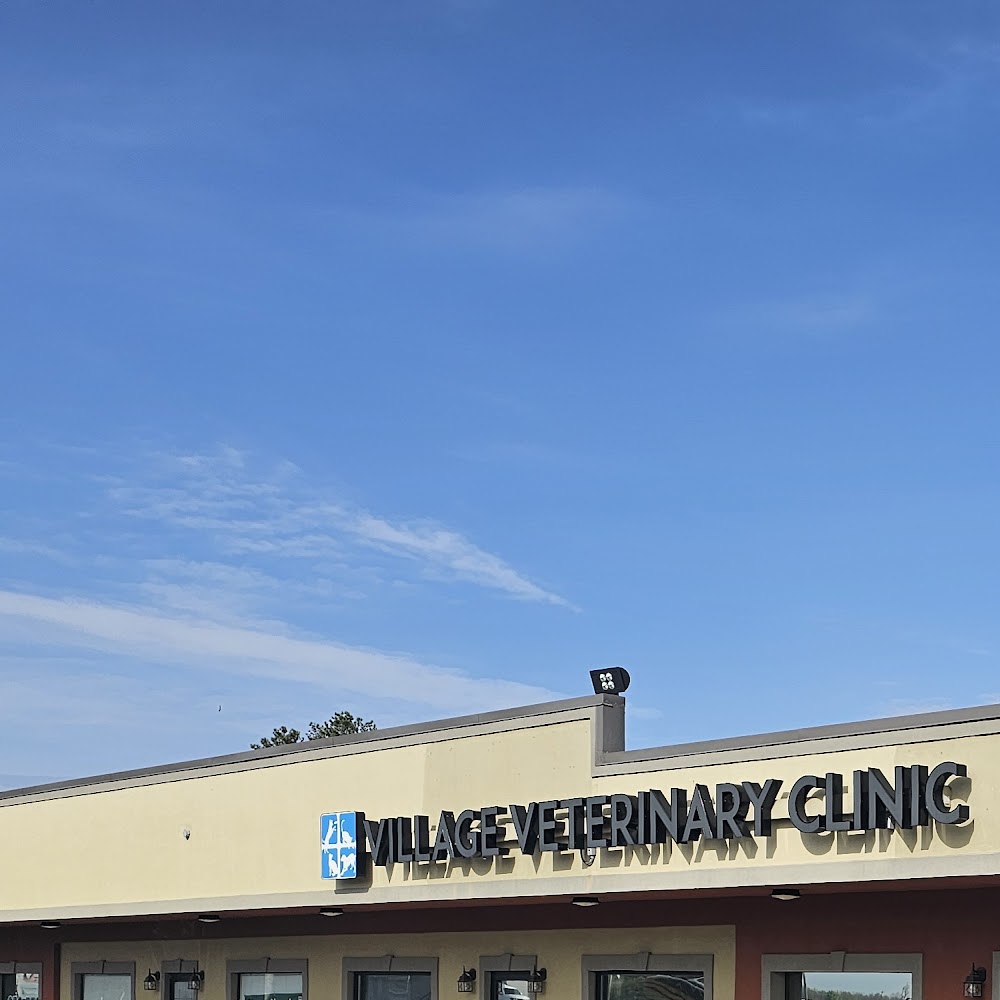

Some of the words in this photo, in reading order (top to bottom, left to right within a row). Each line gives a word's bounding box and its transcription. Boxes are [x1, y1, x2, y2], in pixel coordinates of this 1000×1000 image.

[363, 805, 507, 866] VILLAGE
[509, 778, 783, 855] VETERINARY
[788, 761, 970, 834] CLINIC
